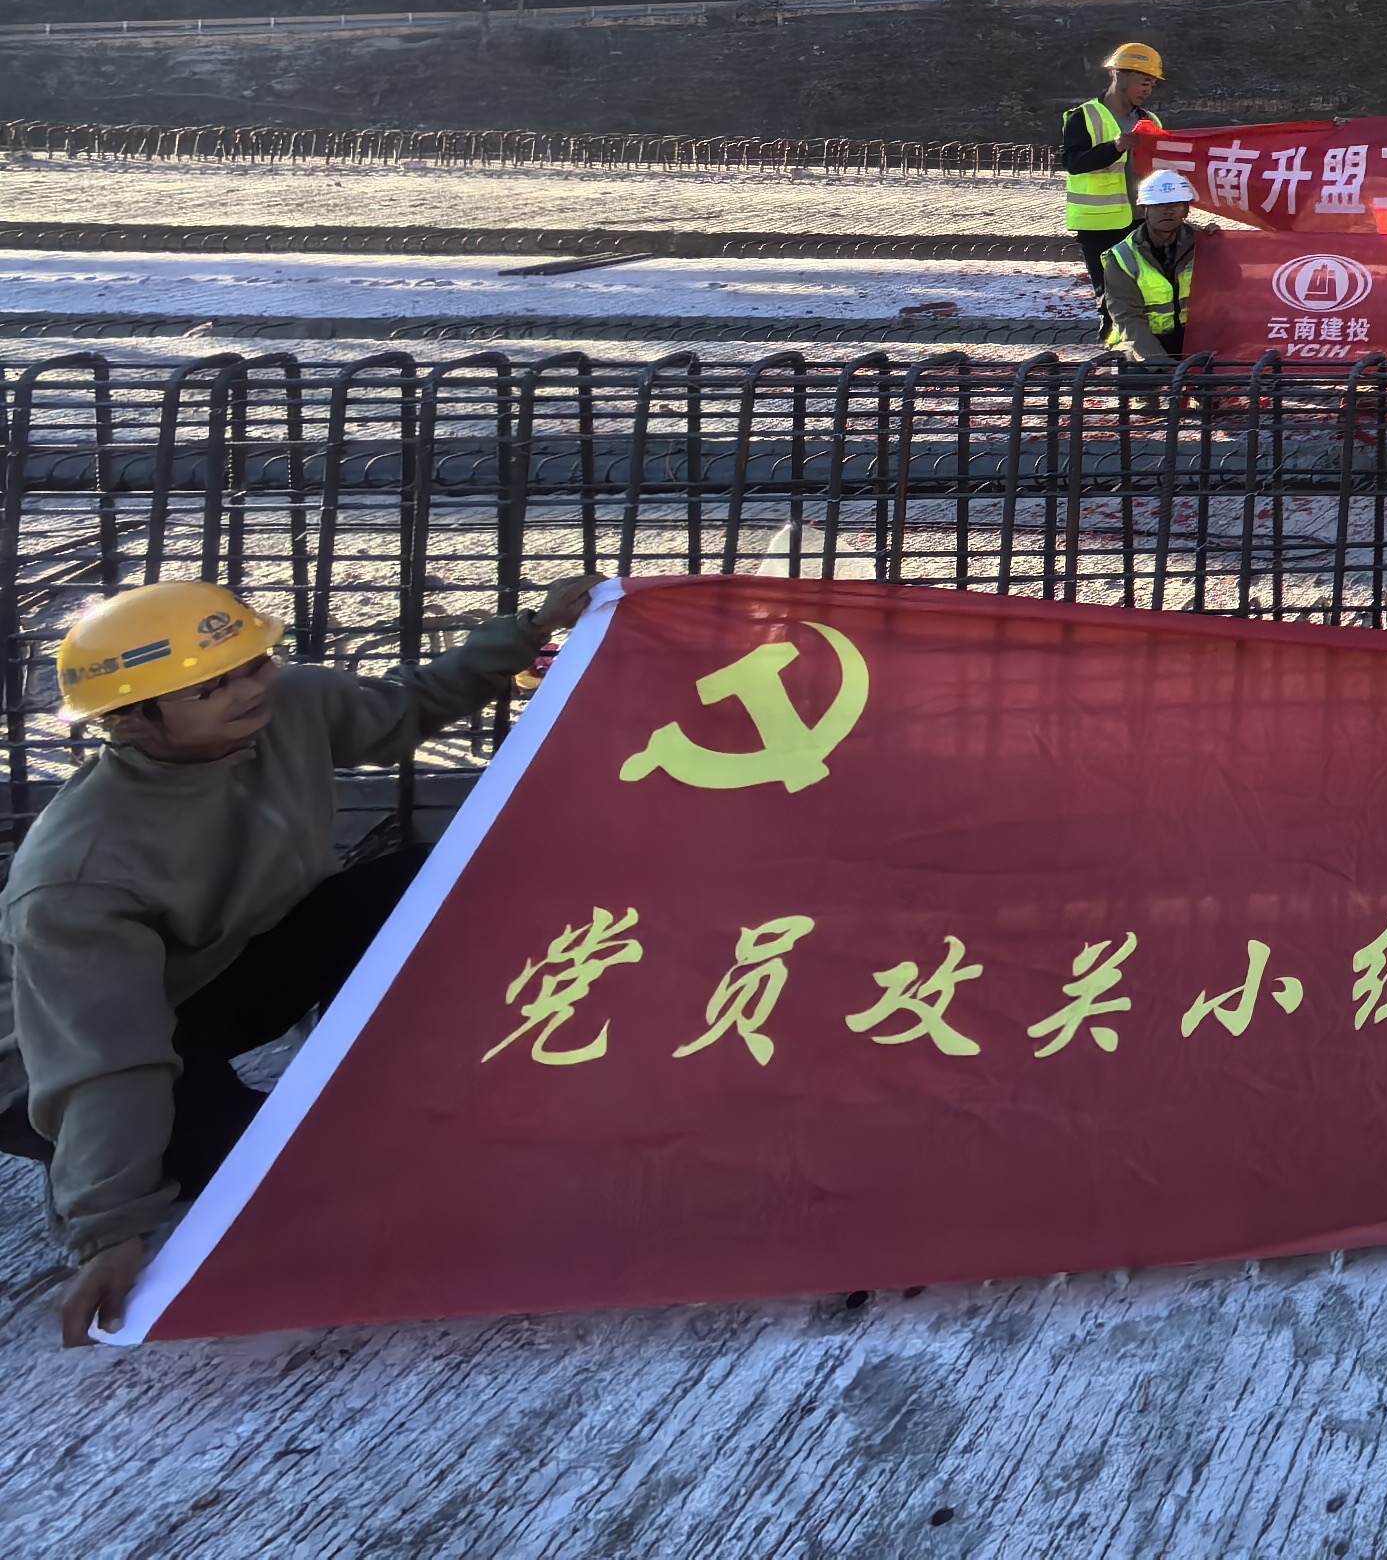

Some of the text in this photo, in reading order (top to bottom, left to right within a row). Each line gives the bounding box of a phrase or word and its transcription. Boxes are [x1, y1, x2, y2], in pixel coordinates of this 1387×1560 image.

[1267, 316, 1371, 342] 云南建投
[1285, 343, 1352, 358] YCIH
